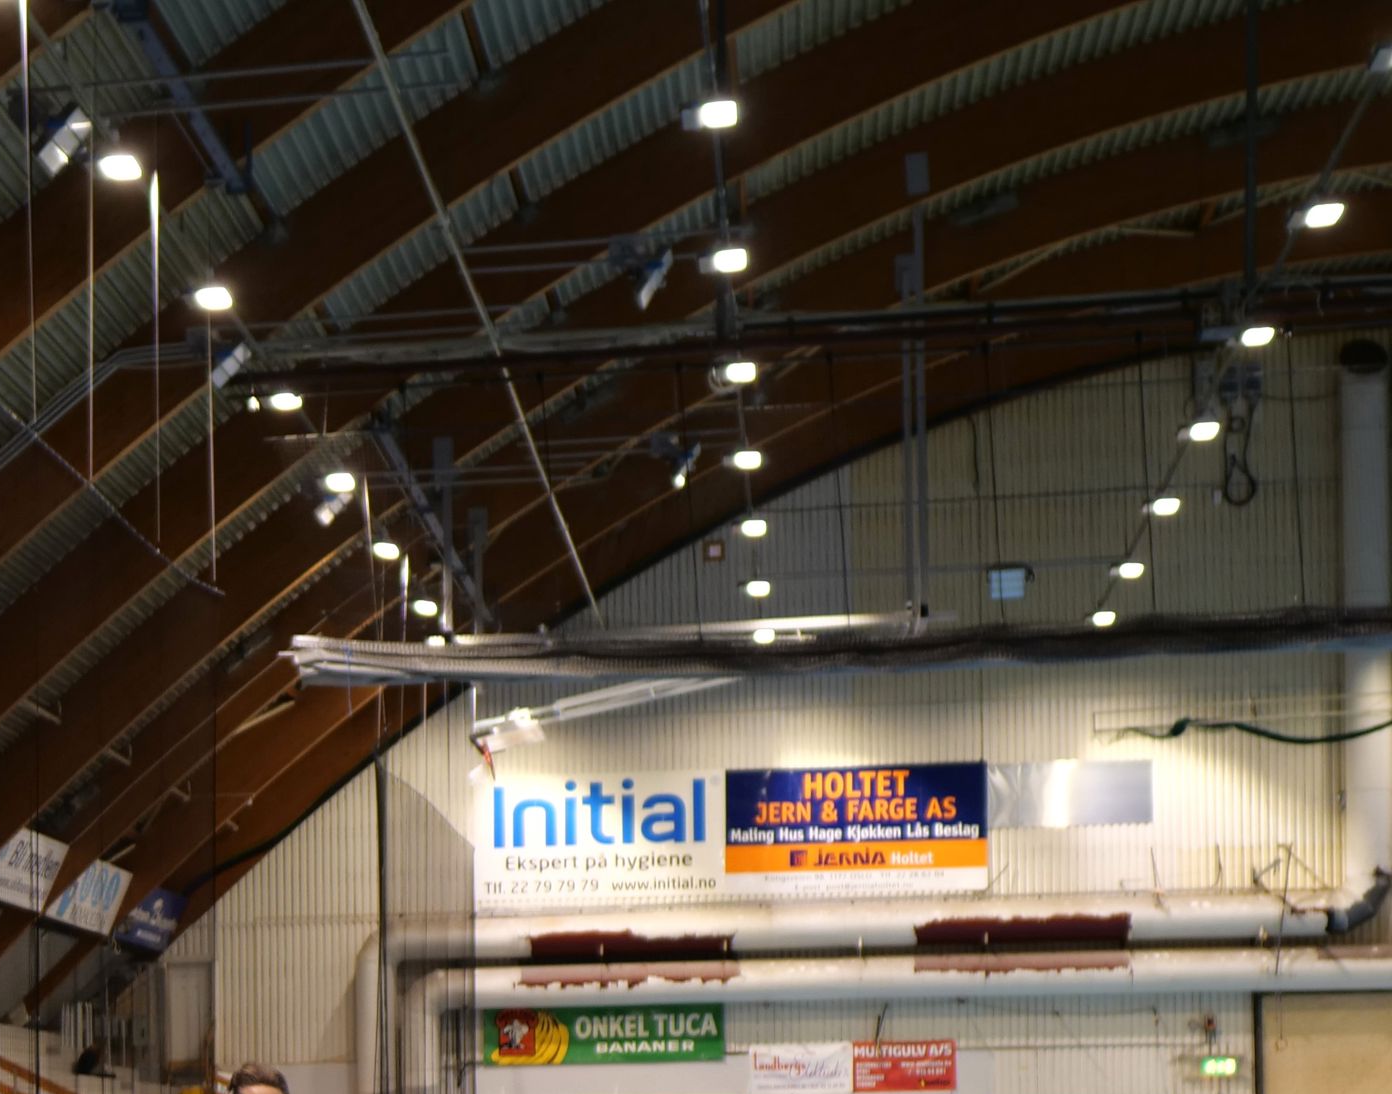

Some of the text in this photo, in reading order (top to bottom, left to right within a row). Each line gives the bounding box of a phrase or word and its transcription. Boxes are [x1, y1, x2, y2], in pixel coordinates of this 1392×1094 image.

[802, 769, 910, 800] HOLTET
[493, 777, 706, 849] Initial
[755, 796, 957, 825] JERN & FARGE AS
[730, 821, 980, 846] Maling Hus Hage Kjøkken Lås Beslag
[504, 851, 694, 873] Ekspert på hygiene
[890, 849, 934, 865] Holtet
[511, 880, 529, 894] 22
[535, 880, 552, 893] 79
[558, 879, 576, 893] 79
[582, 878, 600, 893] 79
[611, 875, 717, 892] www.initial.no
[574, 1012, 719, 1041] ONKEL TUCA
[594, 1038, 695, 1055] BANANER
[854, 1043, 928, 1059] MUTIGULV
